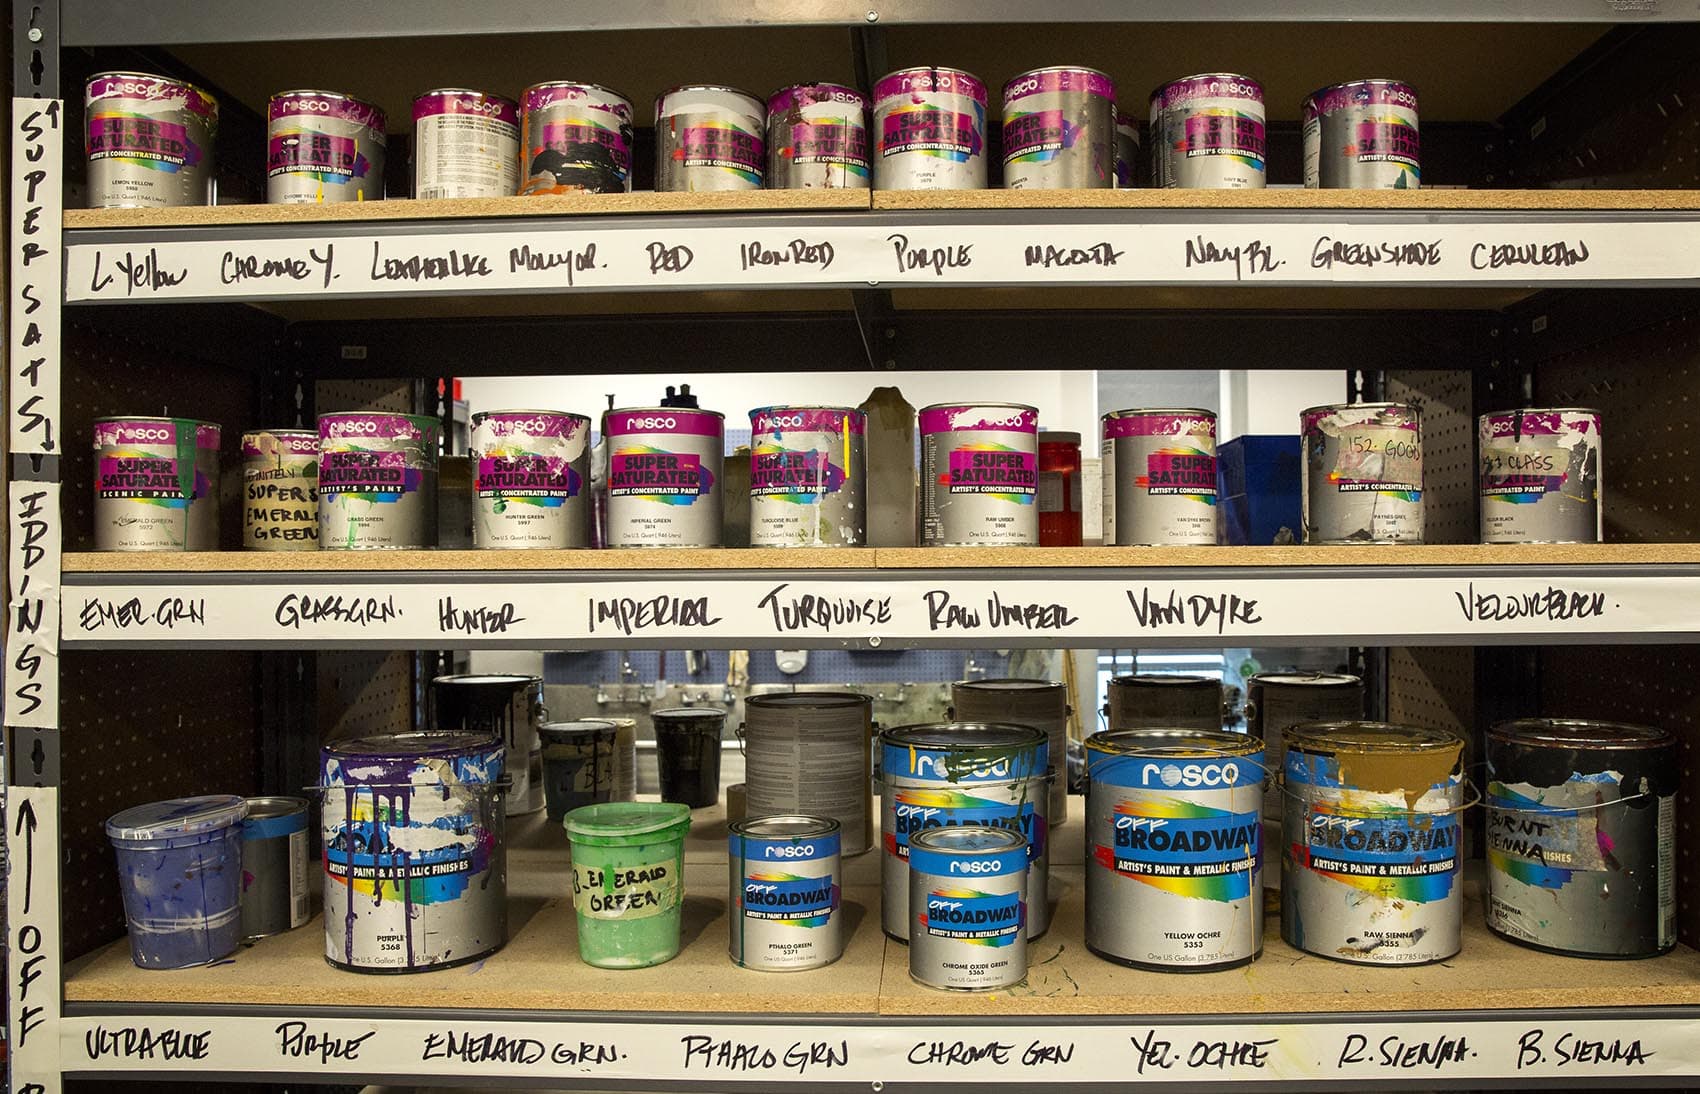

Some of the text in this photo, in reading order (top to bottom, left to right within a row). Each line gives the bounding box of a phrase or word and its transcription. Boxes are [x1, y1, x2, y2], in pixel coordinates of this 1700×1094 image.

[283, 100, 330, 113] rosco
[453, 99, 502, 115] rosco
[900, 112, 953, 128] SUPER
[103, 120, 160, 135] SUPER
[884, 128, 972, 145] SATURATED
[91, 134, 184, 154] SATURATED
[907, 143, 971, 154] CONCENTRATED PAINT
[110, 150, 184, 164] CONCENTRATED PAINT
[1188, 148, 1216, 157] ARTIST'S
[286, 165, 331, 173] CONCENTRATED
[20, 111, 49, 266] SUPER
[646, 241, 693, 274] RED
[17, 284, 46, 433] SATS
[330, 421, 376, 433] rosco
[627, 417, 676, 430] rosco
[116, 429, 169, 441] rosco
[117, 460, 173, 473] SUPER
[332, 454, 380, 467] SUPER
[494, 459, 548, 472] SUPER
[625, 456, 678, 469] SUPER
[758, 455, 804, 468] SUPER
[973, 453, 1024, 469] SUPER
[1508, 455, 1553, 470] CLASS
[320, 468, 401, 482] SATURATED
[480, 473, 567, 487] SATURATED
[612, 470, 699, 484] SATURATED
[952, 469, 1035, 483] SATURATED
[103, 490, 143, 498] SCENIC
[248, 484, 306, 502] SUPER
[255, 527, 319, 540] GREEN
[439, 596, 526, 634] HUNTER
[758, 584, 892, 632] TURQUOISE
[923, 590, 981, 631] RAW
[589, 596, 722, 635] IMPERIAL
[1142, 763, 1239, 786] rosco
[897, 805, 941, 820] OFF
[1116, 817, 1169, 832] OFF
[1311, 816, 1365, 832] OFF
[1116, 822, 1257, 852] BROADWAY
[1311, 825, 1455, 852] BROADWAY
[765, 845, 814, 858] rosco
[950, 860, 1001, 873] rosco
[1118, 861, 1231, 875] ARTIST'S PAINT & METALLIC
[1314, 858, 1454, 875] ARTIST'S PAINT & METALLIC FINISHES
[745, 883, 778, 894] OFF
[746, 888, 832, 906] BROADWAY
[929, 900, 963, 911] OFF
[790, 911, 812, 919] METALLIC
[929, 904, 1019, 924] BROADWAY
[377, 935, 405, 943] PURPLE
[1164, 931, 1221, 940] YELLOW OCHRE
[1364, 931, 1414, 939] RAW SIENNA
[1174, 954, 1196, 962] Gallon
[1372, 953, 1395, 961] Gallon
[942, 962, 968, 970] CHROME
[18, 925, 47, 1048] OFF
[783, 1041, 848, 1074] GRN
[1022, 1040, 1075, 1066] GRN
